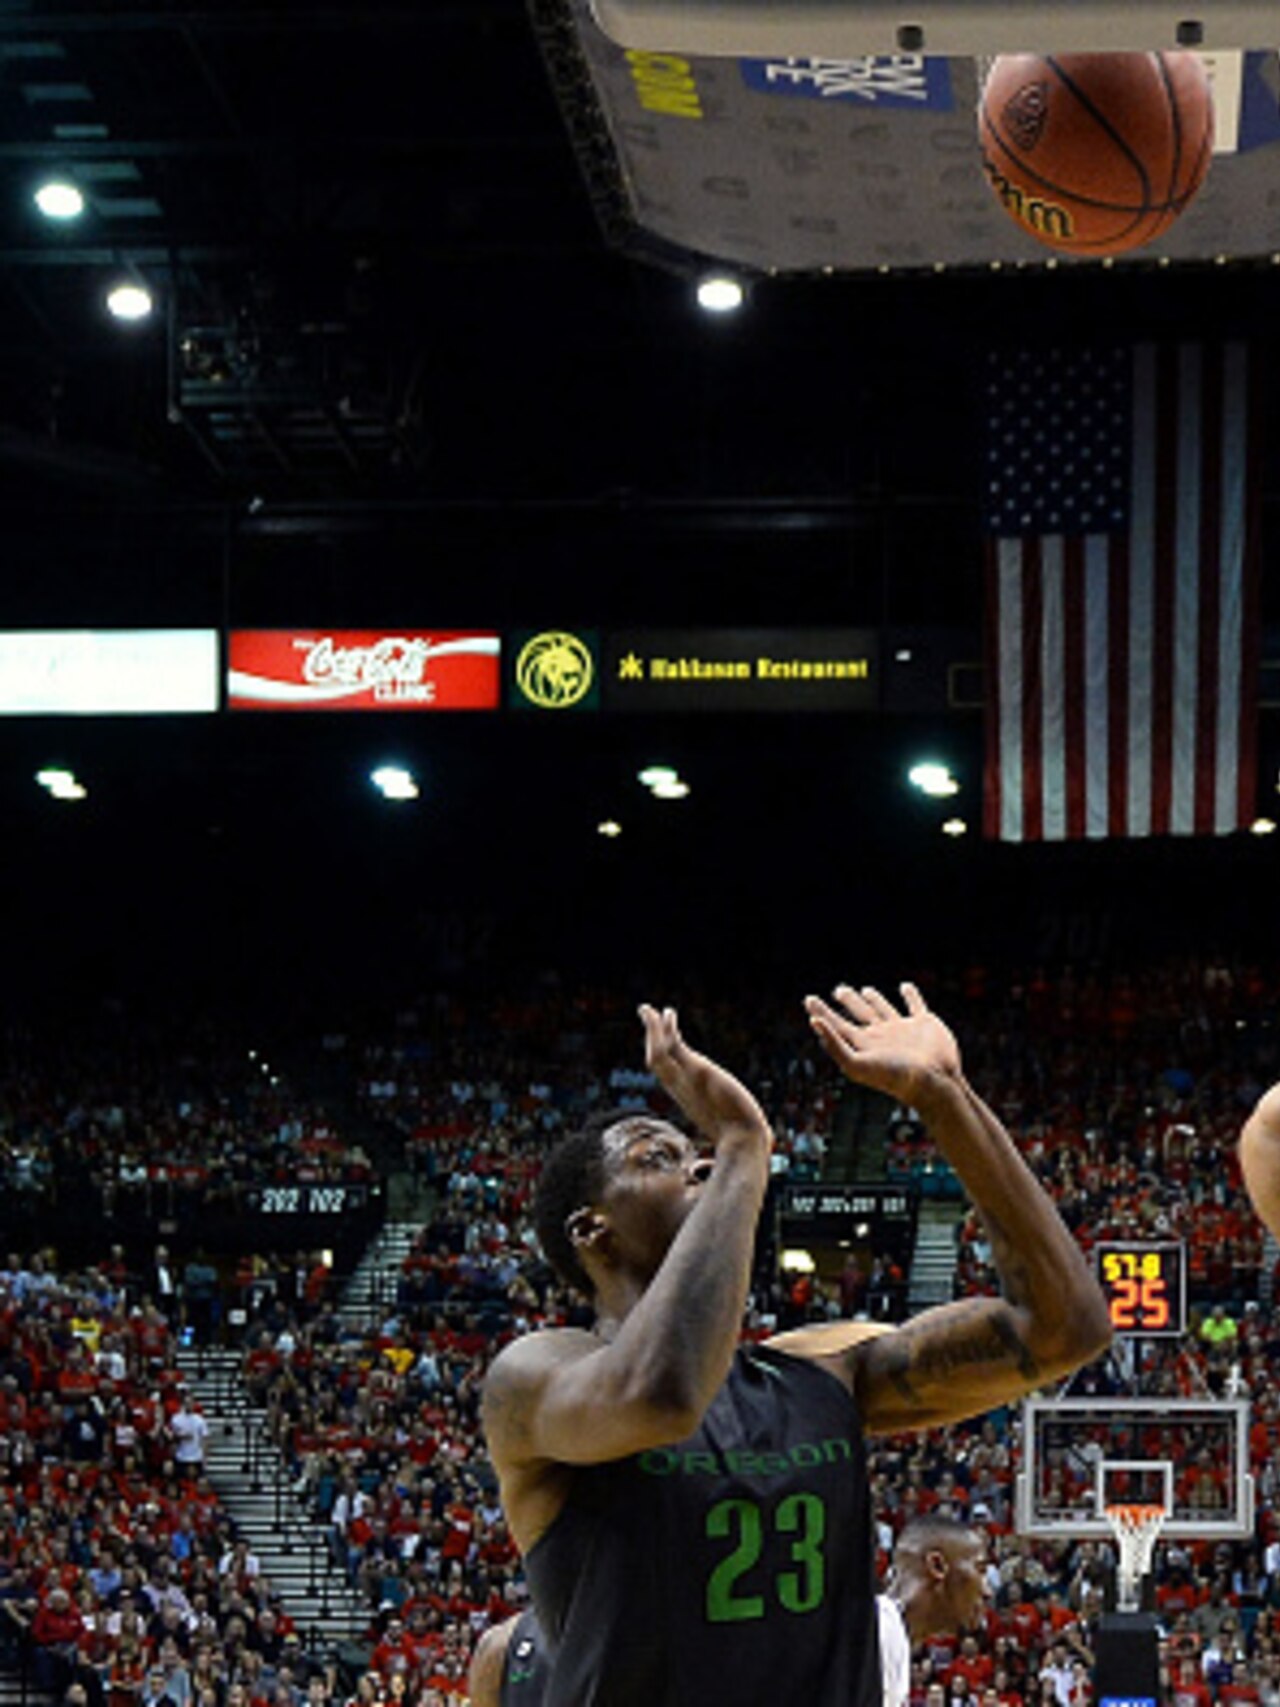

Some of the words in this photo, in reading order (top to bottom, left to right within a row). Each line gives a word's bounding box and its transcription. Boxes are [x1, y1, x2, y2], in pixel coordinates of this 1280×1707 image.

[757, 659, 868, 679] Restaurant
[1109, 1279, 1169, 1328] 25
[705, 1493, 825, 1622] 23
